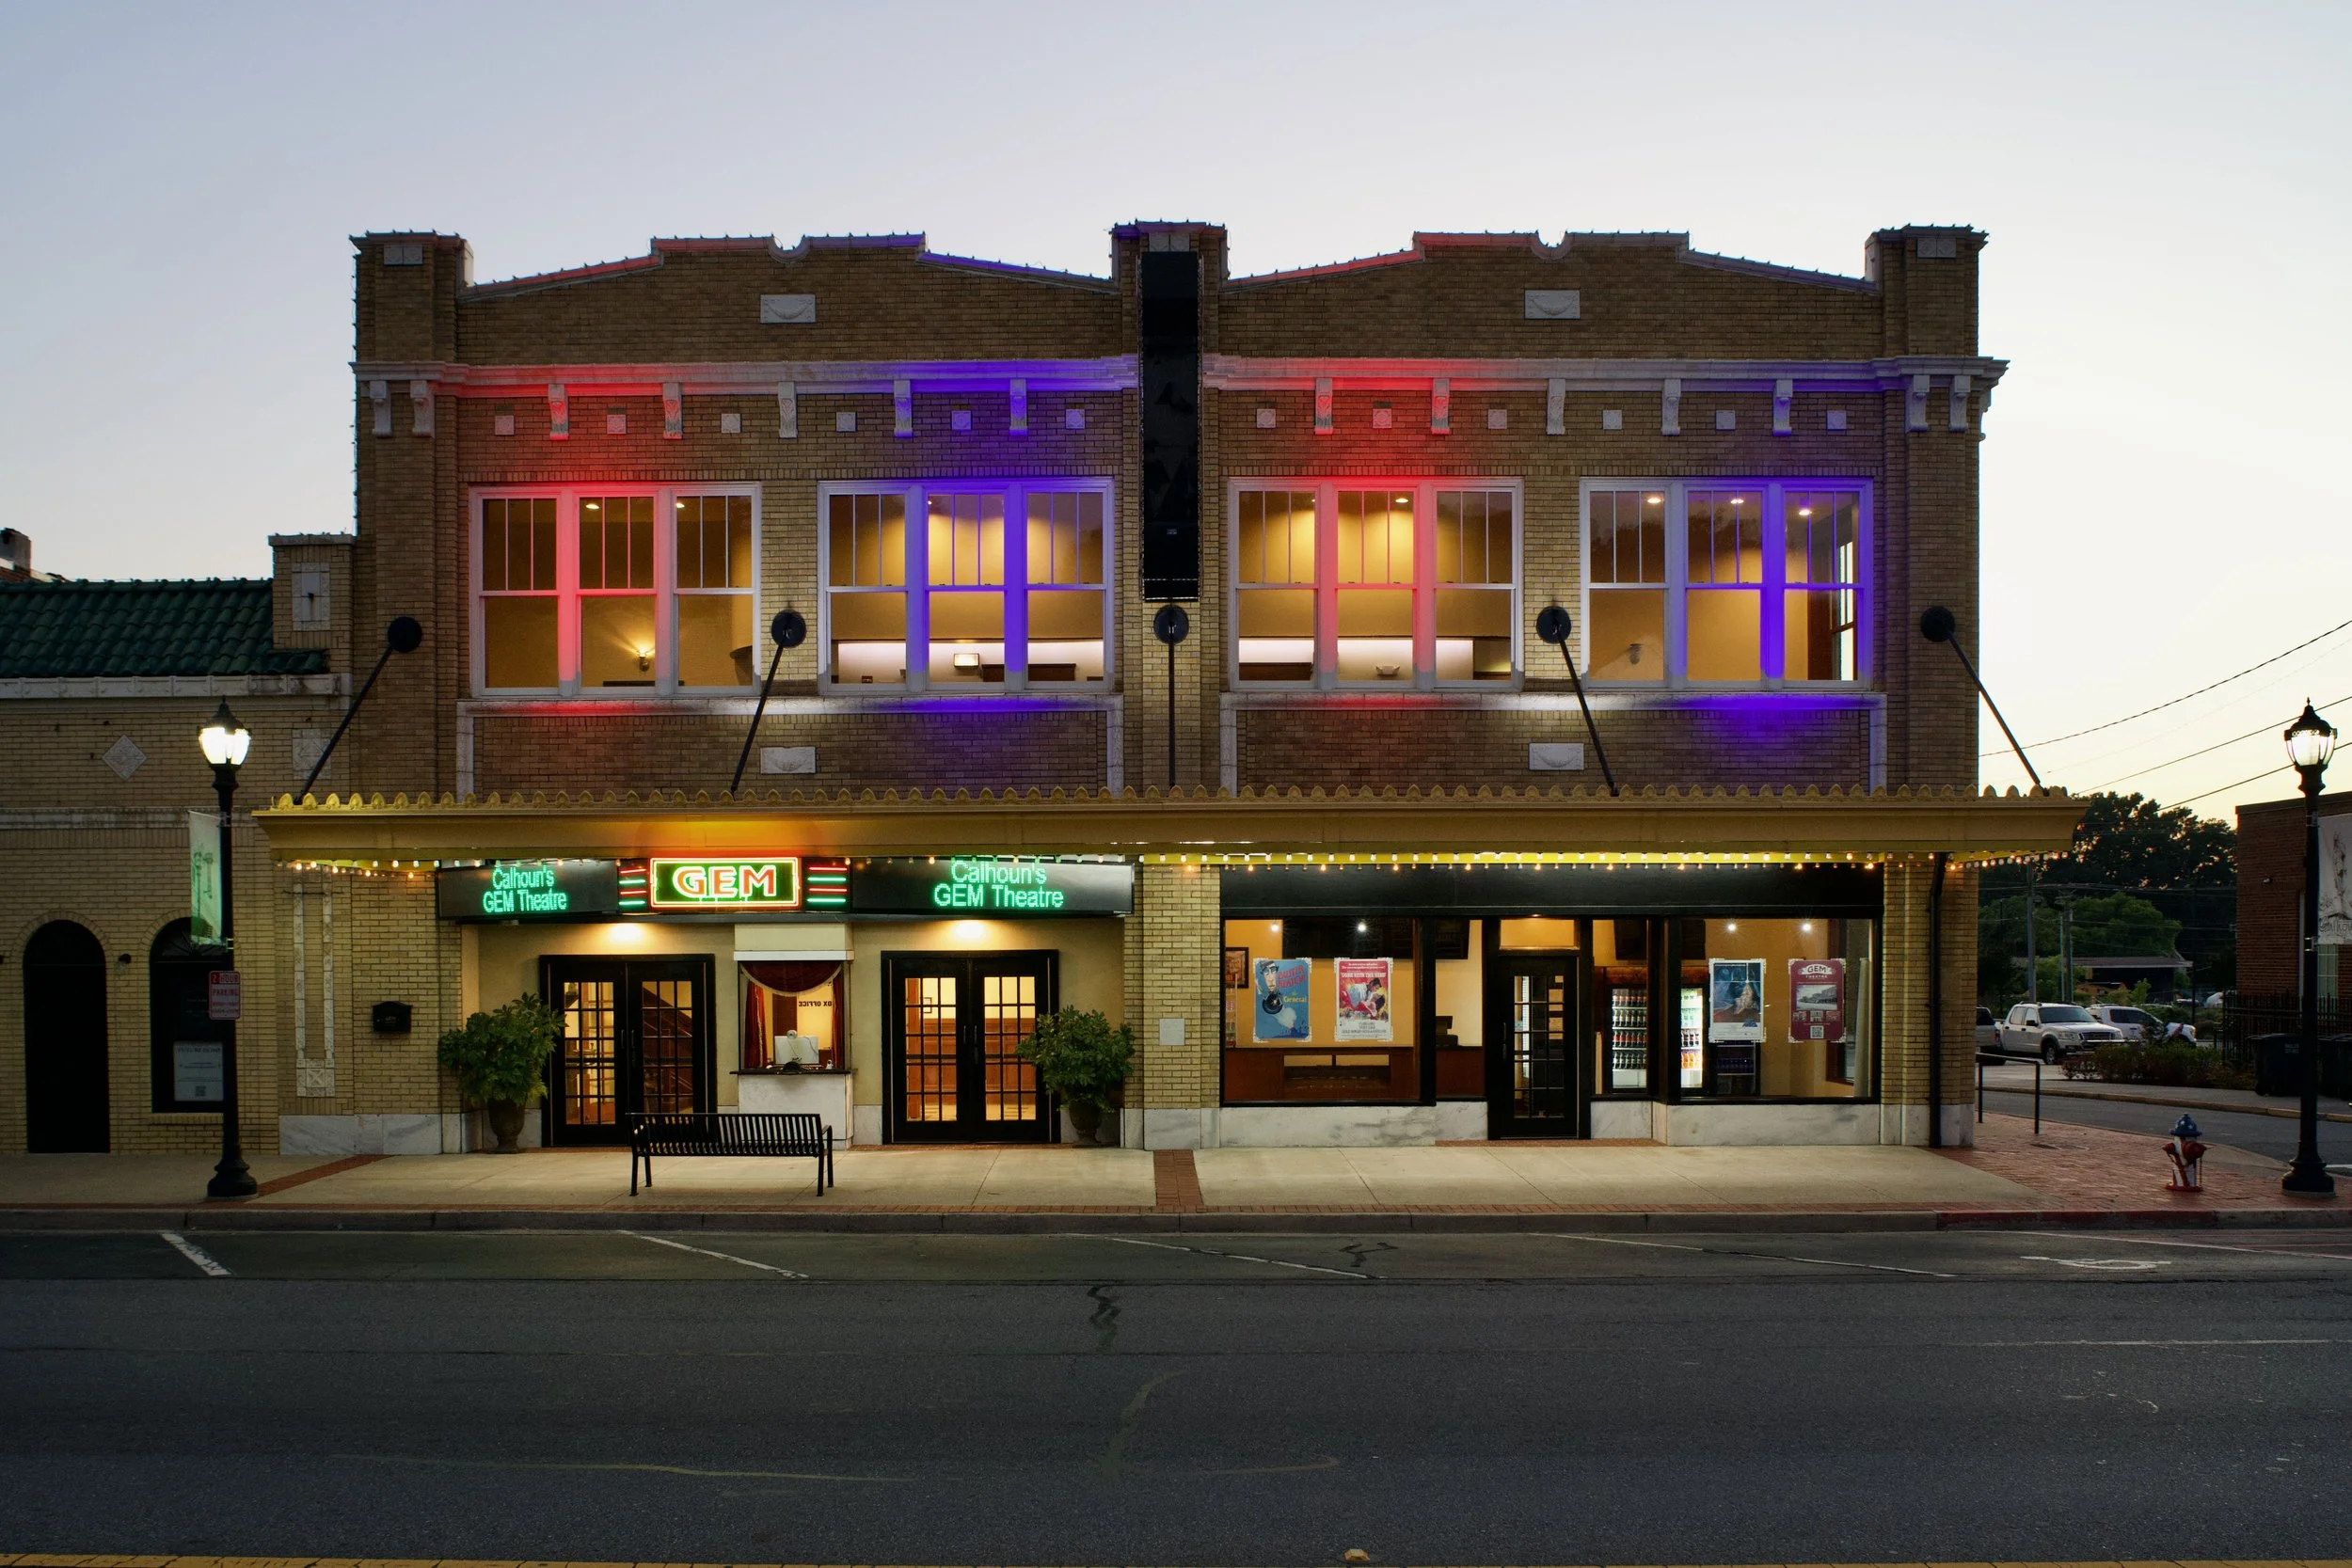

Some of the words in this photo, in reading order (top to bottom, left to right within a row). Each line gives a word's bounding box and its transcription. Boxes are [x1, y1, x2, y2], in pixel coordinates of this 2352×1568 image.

[492, 865, 555, 890] Calhoun's
[672, 864, 777, 898] GEM
[950, 860, 1047, 885] Calhoun's
[483, 890, 515, 912] GEM
[516, 888, 567, 911] Theatre
[934, 883, 984, 907] GEM
[991, 884, 1064, 908] Theatre
[213, 973, 218, 983] 2
[1807, 965, 1826, 974] GEM
